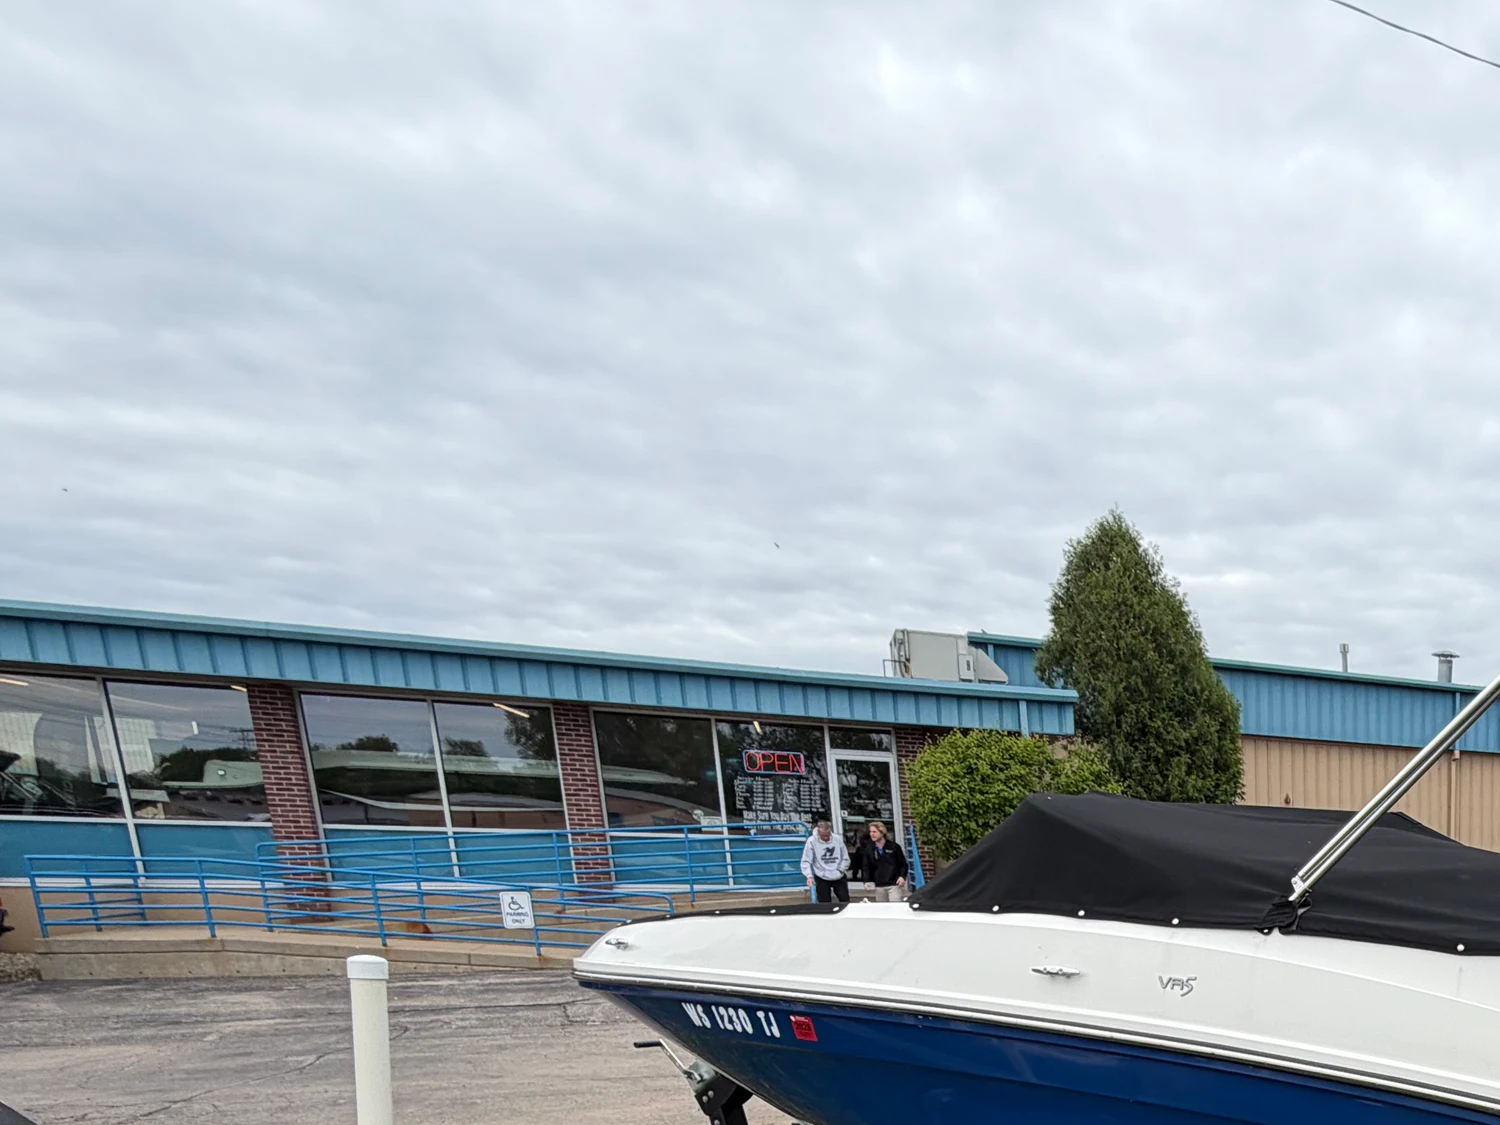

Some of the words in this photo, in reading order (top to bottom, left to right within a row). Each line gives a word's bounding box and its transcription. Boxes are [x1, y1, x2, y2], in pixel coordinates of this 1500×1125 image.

[745, 752, 804, 774] OPEN
[681, 1002, 711, 1029] WS
[711, 1005, 753, 1035] 1230
[756, 1010, 781, 1038] TJ
